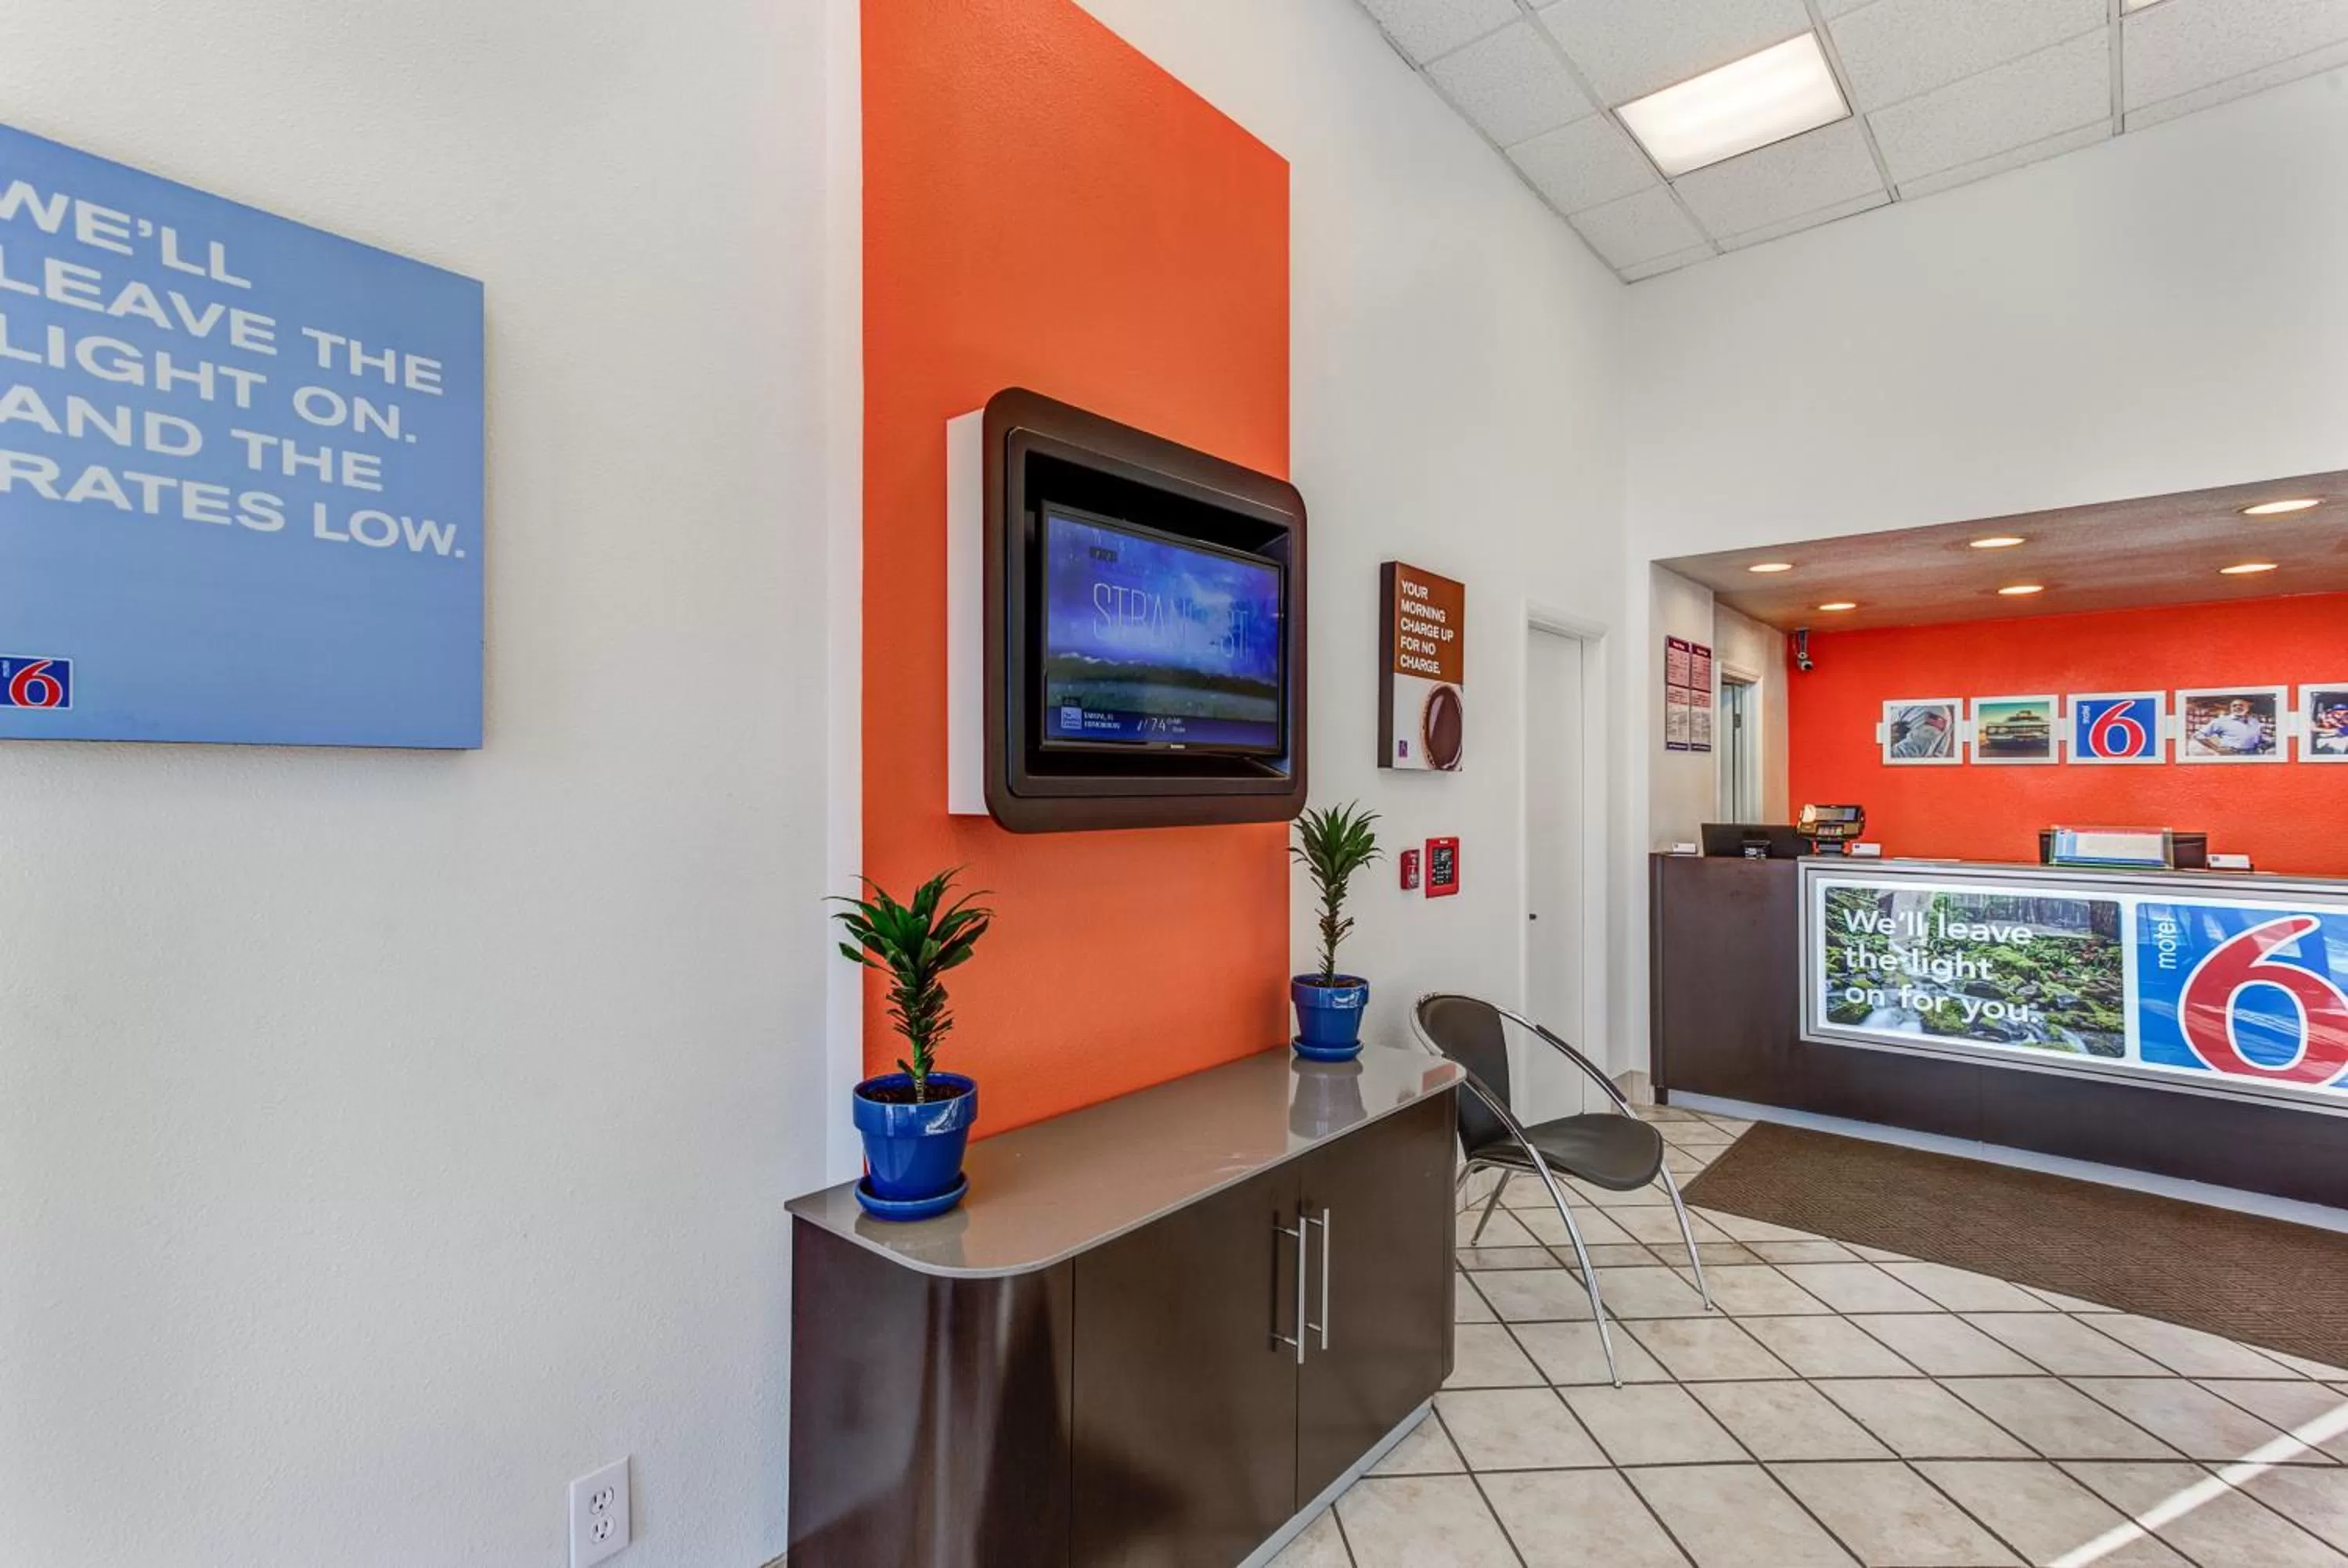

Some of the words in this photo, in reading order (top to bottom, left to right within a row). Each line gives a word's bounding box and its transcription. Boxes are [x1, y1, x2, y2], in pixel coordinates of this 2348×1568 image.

[0, 243, 278, 355] LEAVE
[301, 325, 444, 397] THE
[0, 311, 268, 409] LIGHT
[292, 386, 417, 444] ON.
[0, 383, 203, 457] AND
[230, 428, 384, 492] THE
[0, 448, 286, 532] RATES
[313, 502, 466, 559] LOW.
[1402, 580, 1428, 600] YOUR
[1400, 617, 1440, 638] CHARGE
[1441, 628, 1454, 642] UP
[1401, 599, 1446, 624] MORNING
[1400, 635, 1421, 652] FOR
[1421, 642, 1436, 656] NO
[1400, 653, 1441, 674] CHARGE.
[9, 659, 63, 709] 6
[2088, 700, 2147, 759] 6
[1939, 912, 2033, 945] leave
[1844, 944, 1898, 971] the
[1912, 947, 1993, 984] light
[1845, 986, 1885, 1007] on
[1899, 984, 1950, 1013] for
[1959, 998, 2040, 1024] you.
[2156, 915, 2179, 969] motel
[2177, 914, 2348, 1086] 6
